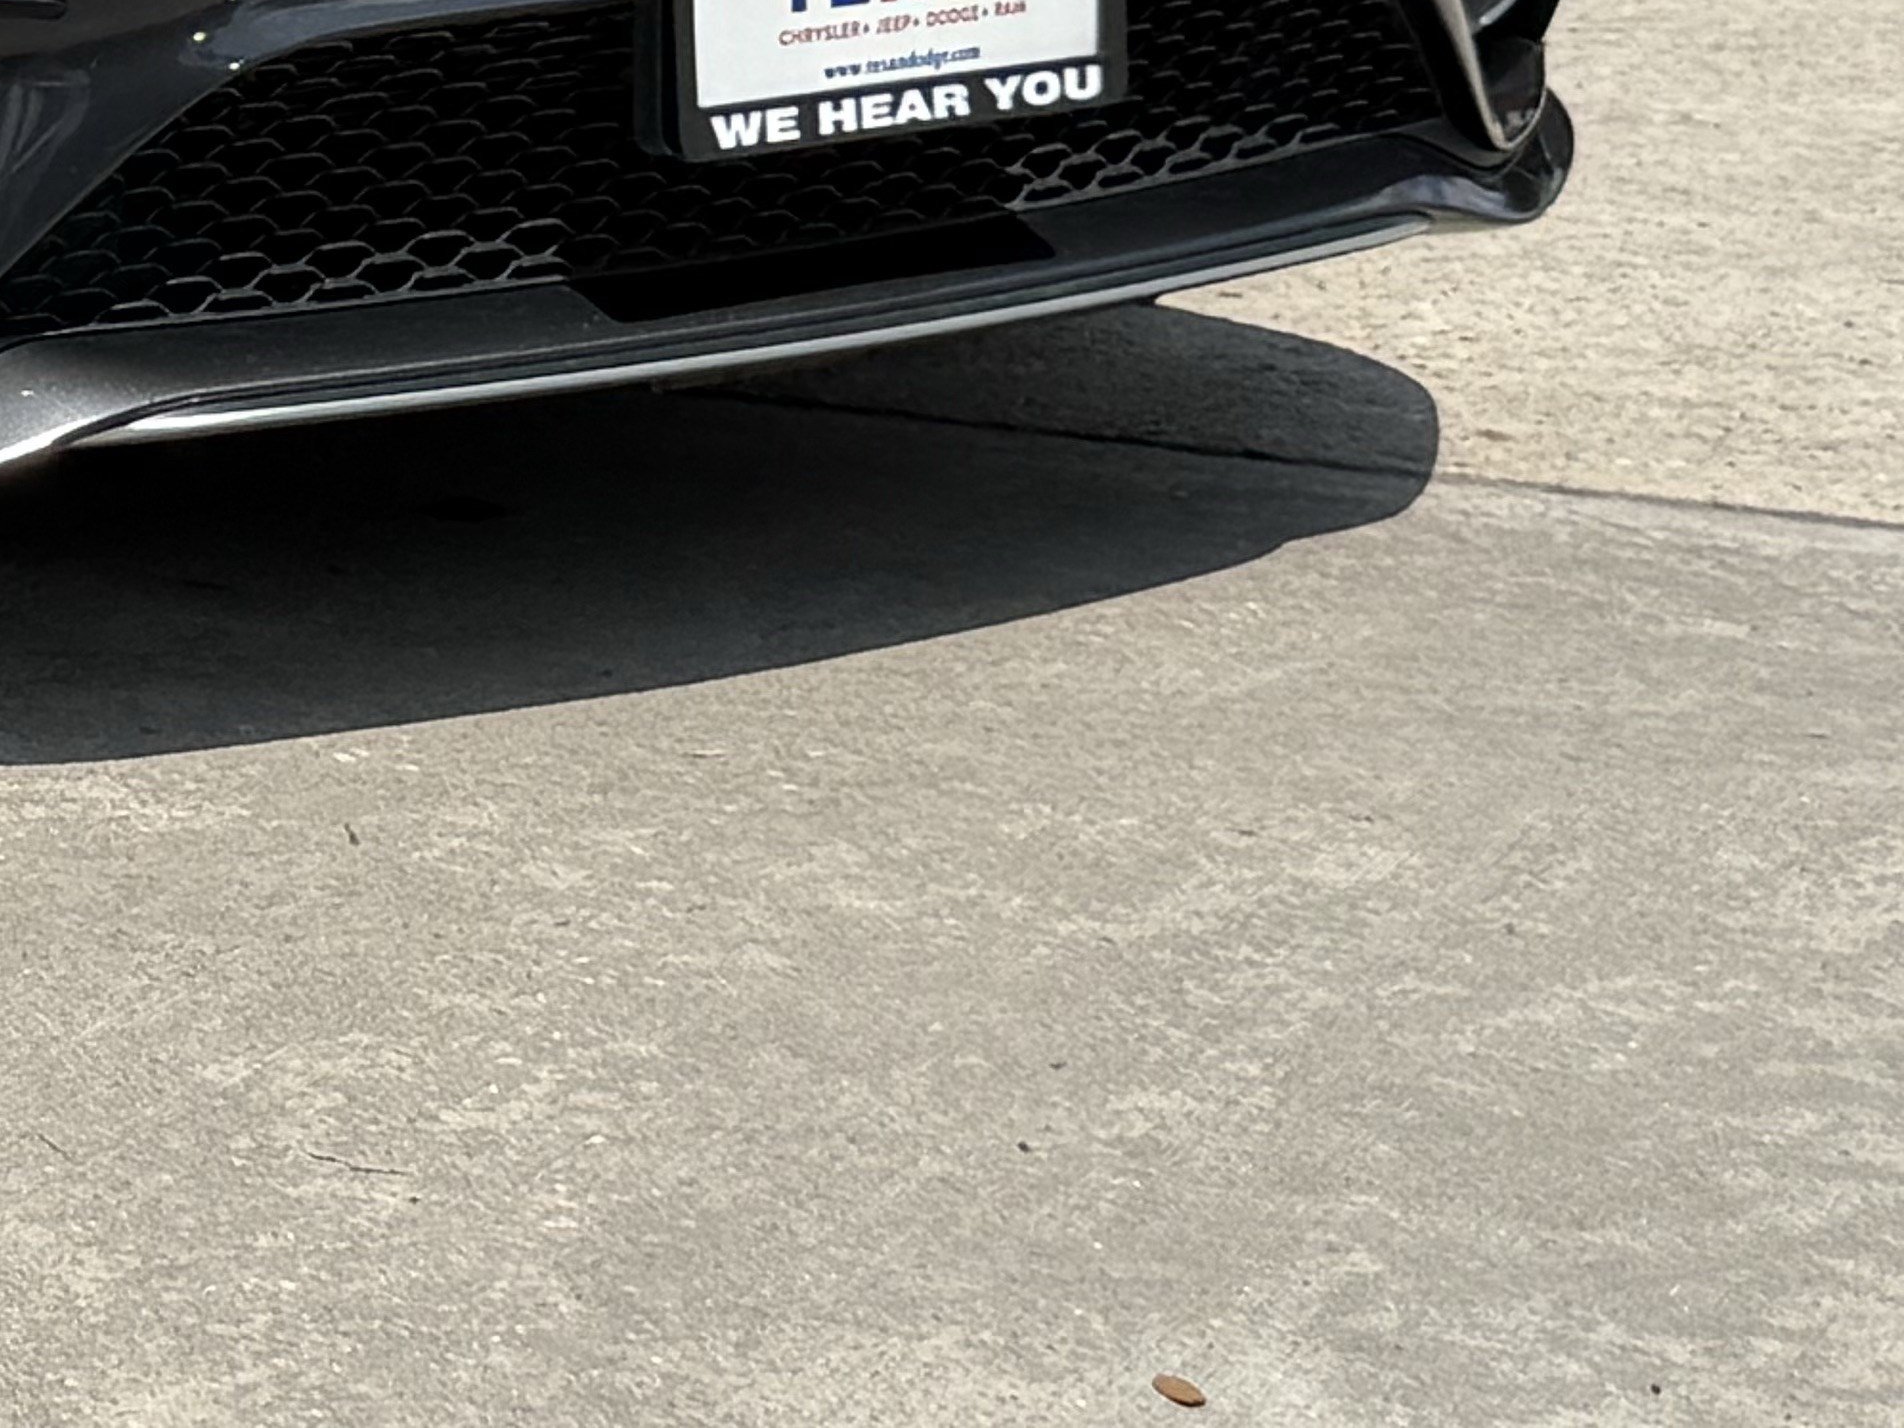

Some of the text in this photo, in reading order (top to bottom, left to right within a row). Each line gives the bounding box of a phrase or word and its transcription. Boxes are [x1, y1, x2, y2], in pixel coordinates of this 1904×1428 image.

[778, 21, 861, 46] CHRYSLER
[876, 14, 911, 34] JEEP
[926, 4, 979, 27] DODGE
[709, 65, 1103, 150] WE HEAR YOU
